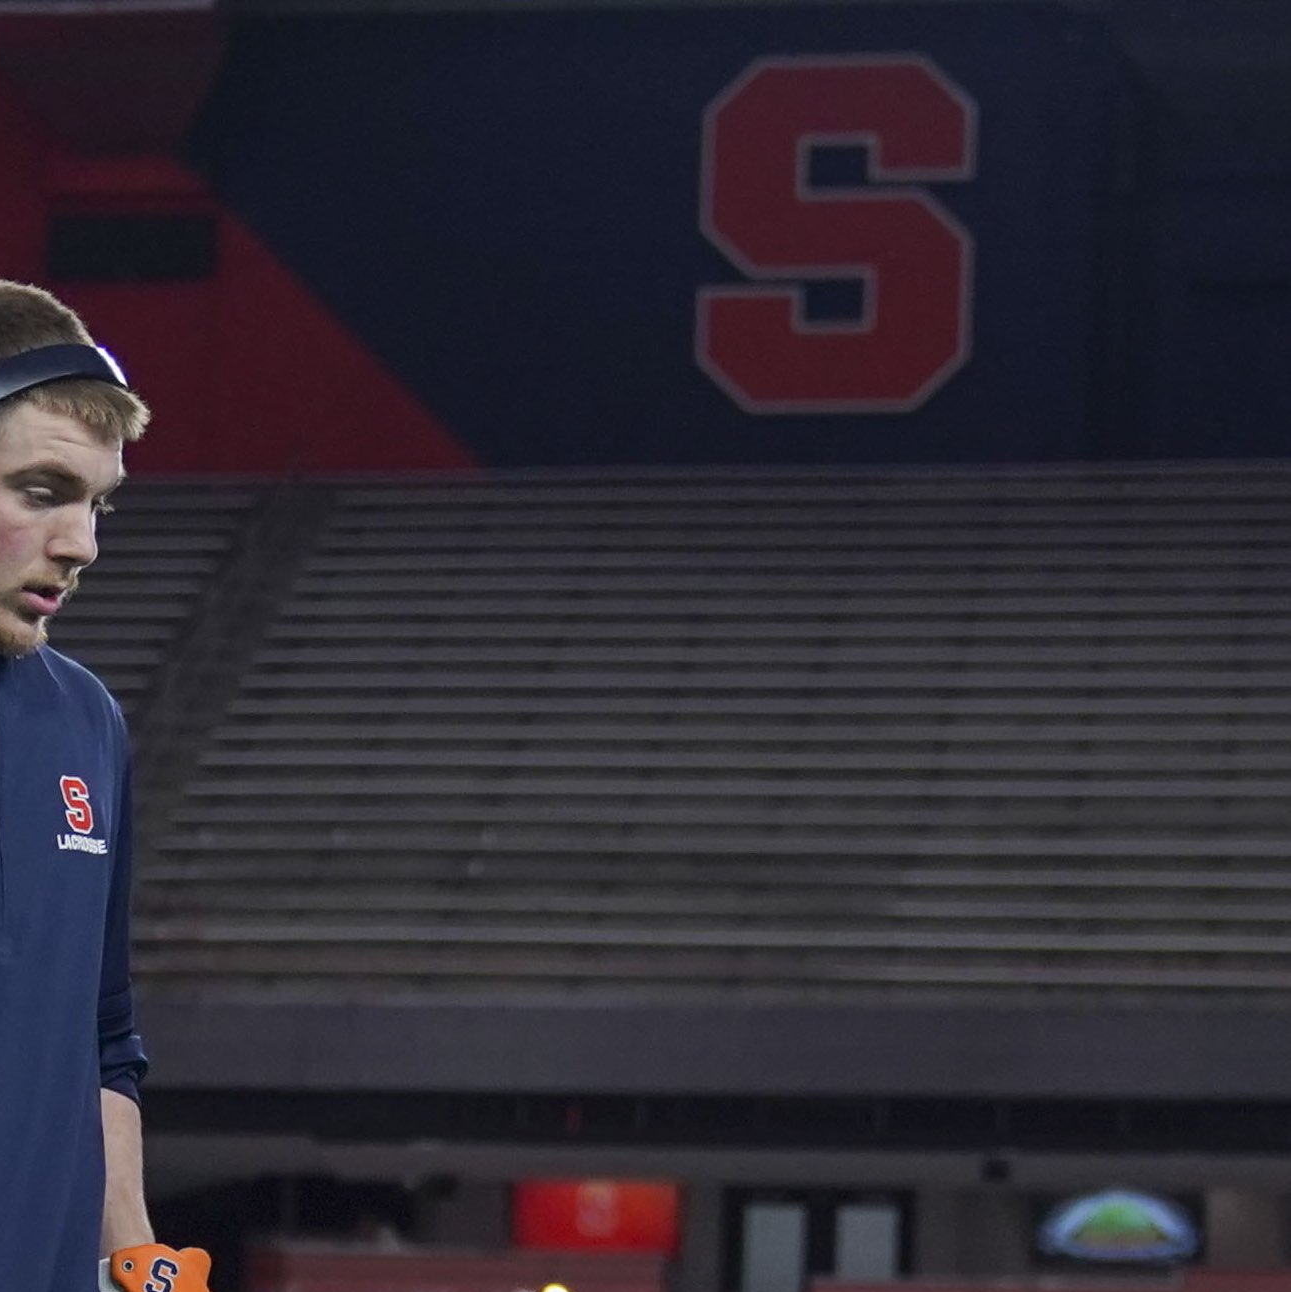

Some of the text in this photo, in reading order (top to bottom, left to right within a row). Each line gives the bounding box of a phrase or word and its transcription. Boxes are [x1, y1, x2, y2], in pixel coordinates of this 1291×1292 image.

[694, 52, 979, 414] S
[59, 775, 94, 834] S
[57, 834, 108, 854] LACROSSE
